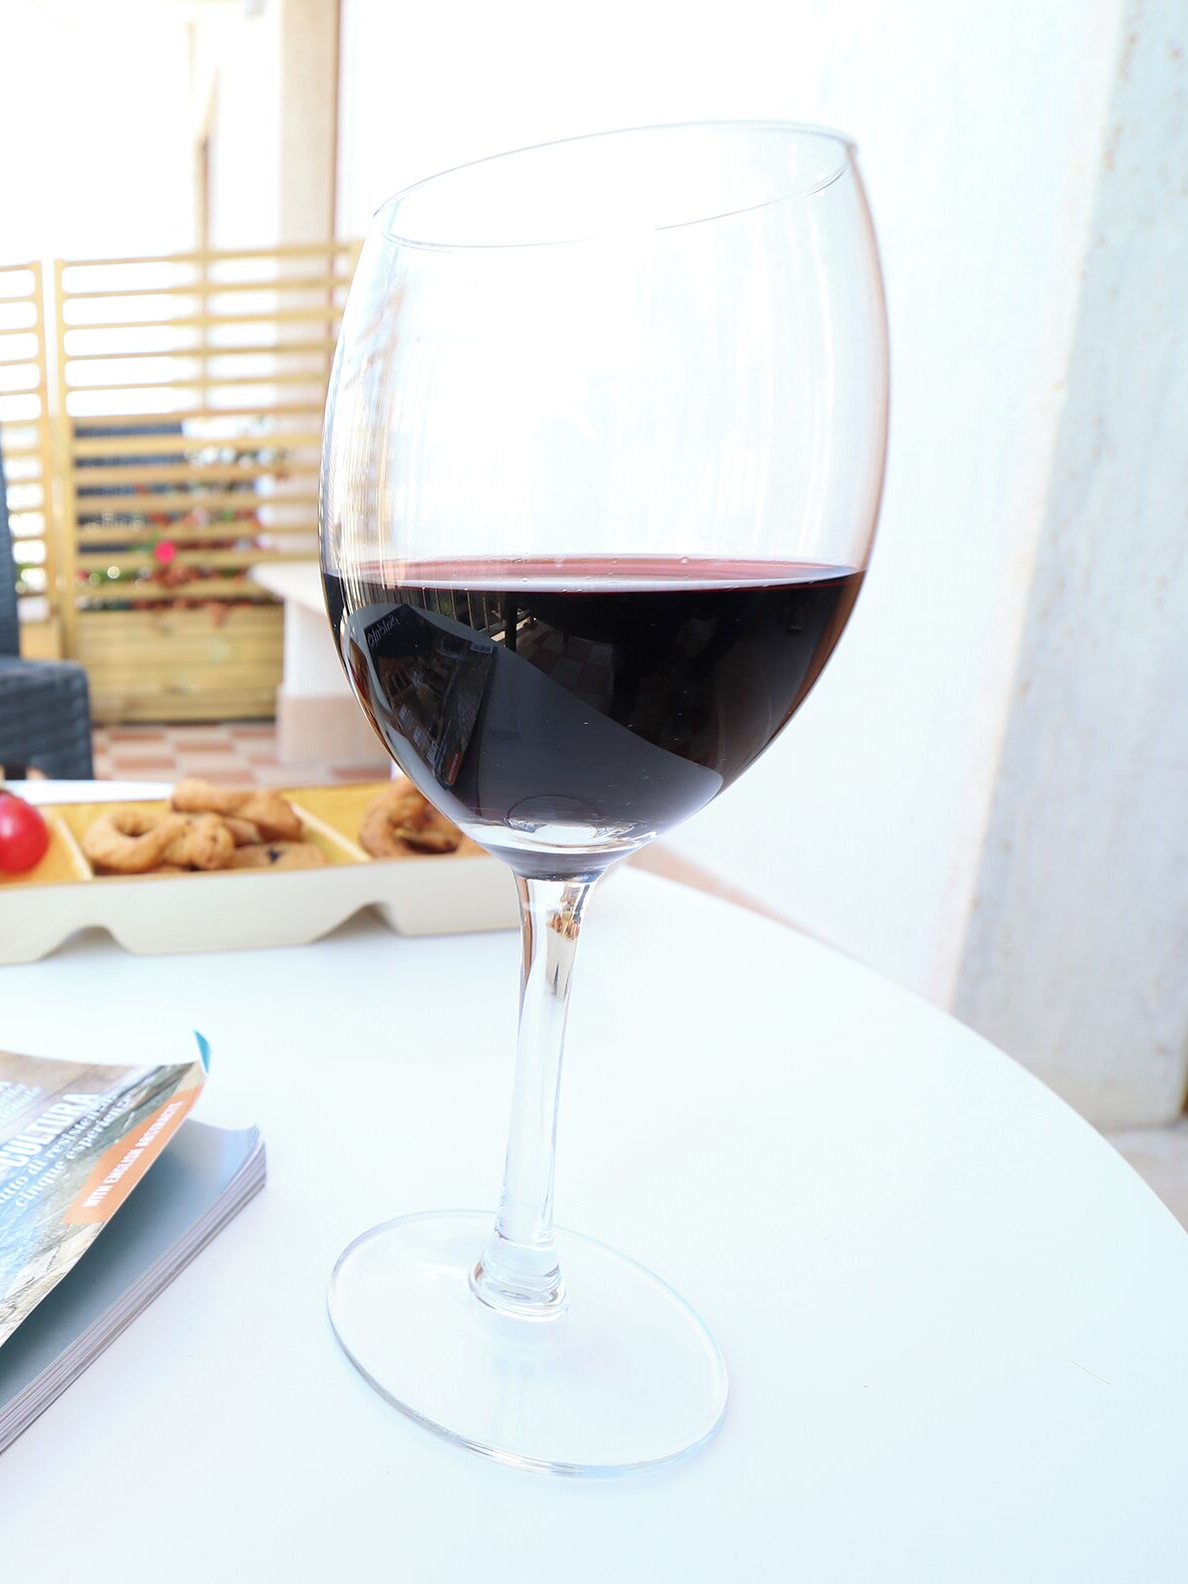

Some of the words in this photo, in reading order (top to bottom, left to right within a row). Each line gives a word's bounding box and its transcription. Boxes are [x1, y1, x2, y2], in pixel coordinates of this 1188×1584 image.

[15, 1160, 67, 1208] cinque
[27, 1159, 47, 1175] di
[81, 1185, 113, 1207] WITH
[103, 1148, 145, 1184] ENGLISH
